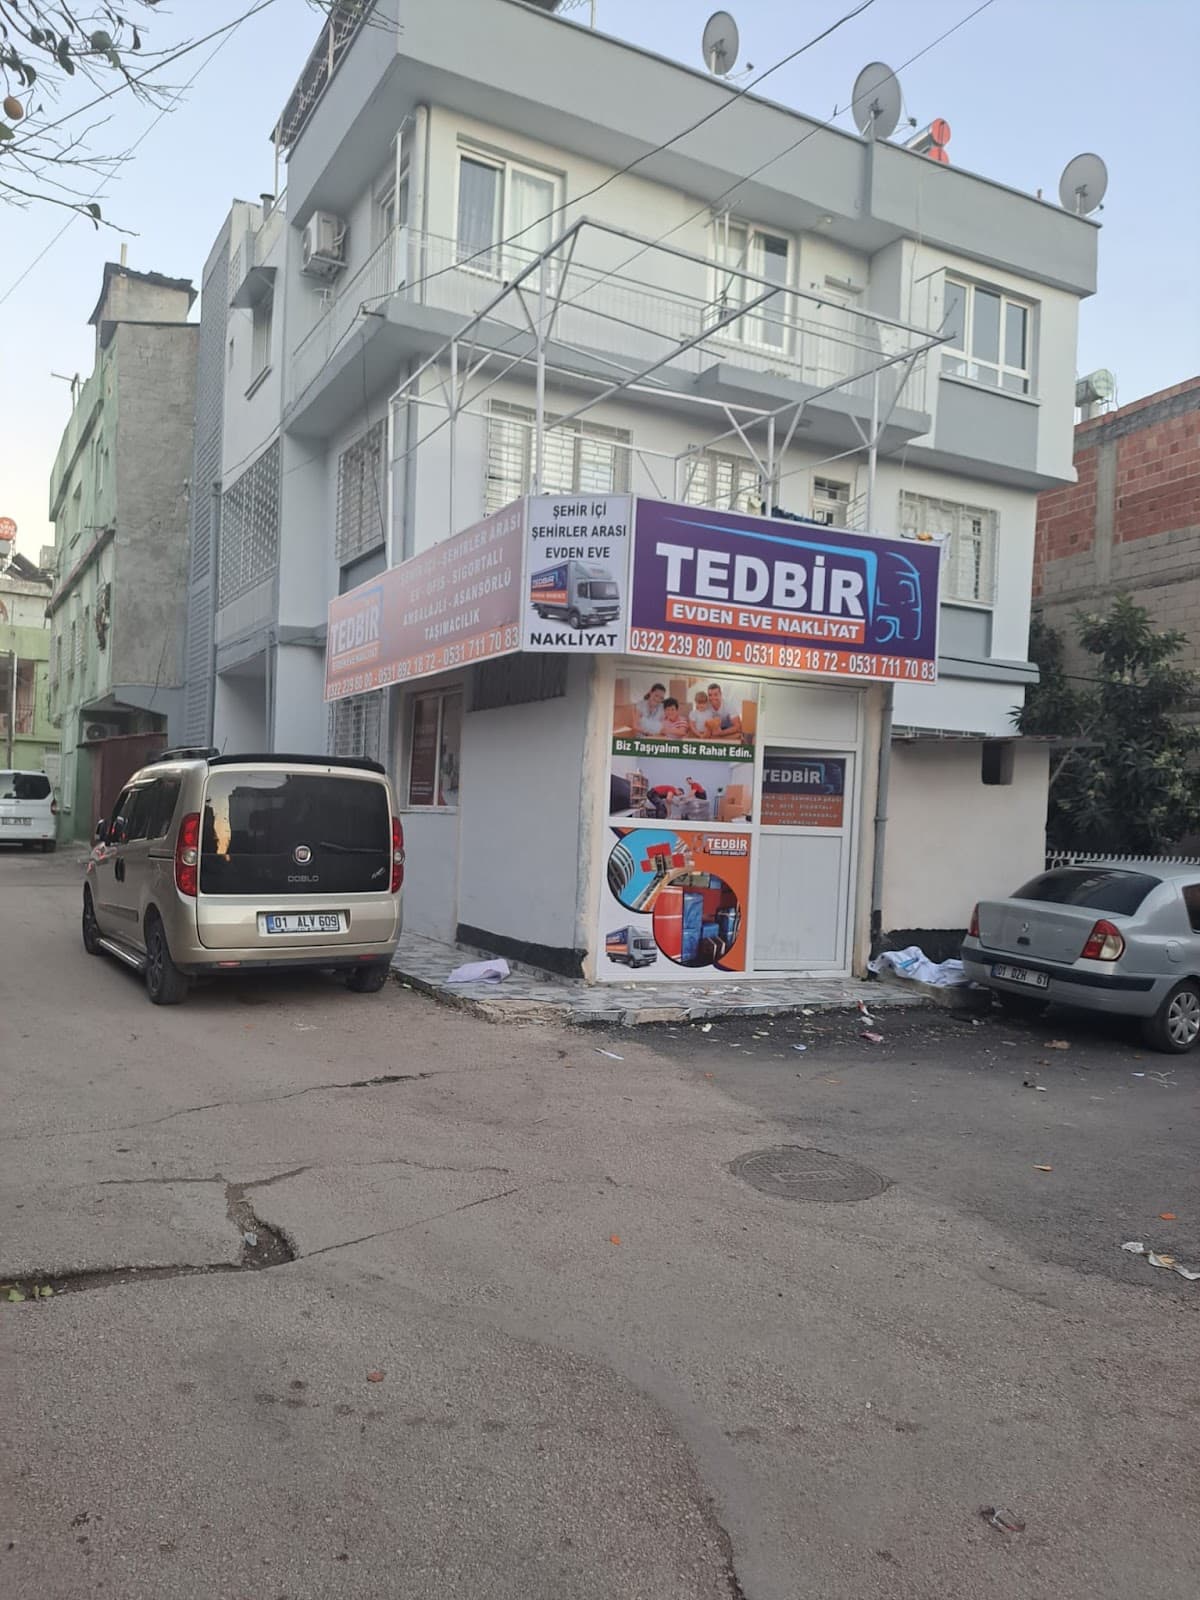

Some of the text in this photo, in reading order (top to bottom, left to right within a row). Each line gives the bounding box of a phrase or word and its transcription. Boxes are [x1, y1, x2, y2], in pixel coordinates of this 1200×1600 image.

[553, 501, 607, 520] ŞEHİR İÇİ
[532, 523, 627, 541] ŞEHİRLER ARASI
[545, 546, 611, 559] EVDEN EVE
[655, 542, 864, 616] TEDBİR
[672, 604, 860, 639] EVDEN EVE NAKLİYAT
[443, 642, 465, 665] 0531
[469, 637, 485, 657] 711
[490, 631, 502, 651] 70
[505, 626, 519, 648] 83
[530, 629, 618, 646] NAKLİYAT
[631, 630, 664, 652] 0322
[668, 634, 693, 655] 239
[696, 638, 712, 658] 80
[716, 640, 732, 660] 00
[744, 643, 774, 664] 0531
[778, 646, 801, 667] 892
[805, 649, 819, 669] 18
[824, 652, 838, 671] 72
[850, 655, 877, 674] 0531
[881, 657, 900, 676] 711
[905, 660, 918, 678] 70
[921, 661, 935, 680] 83
[615, 740, 752, 758] Biz Taşıyalım Siz Rahat Edin.
[275, 913, 337, 928] 01 ALV 609
